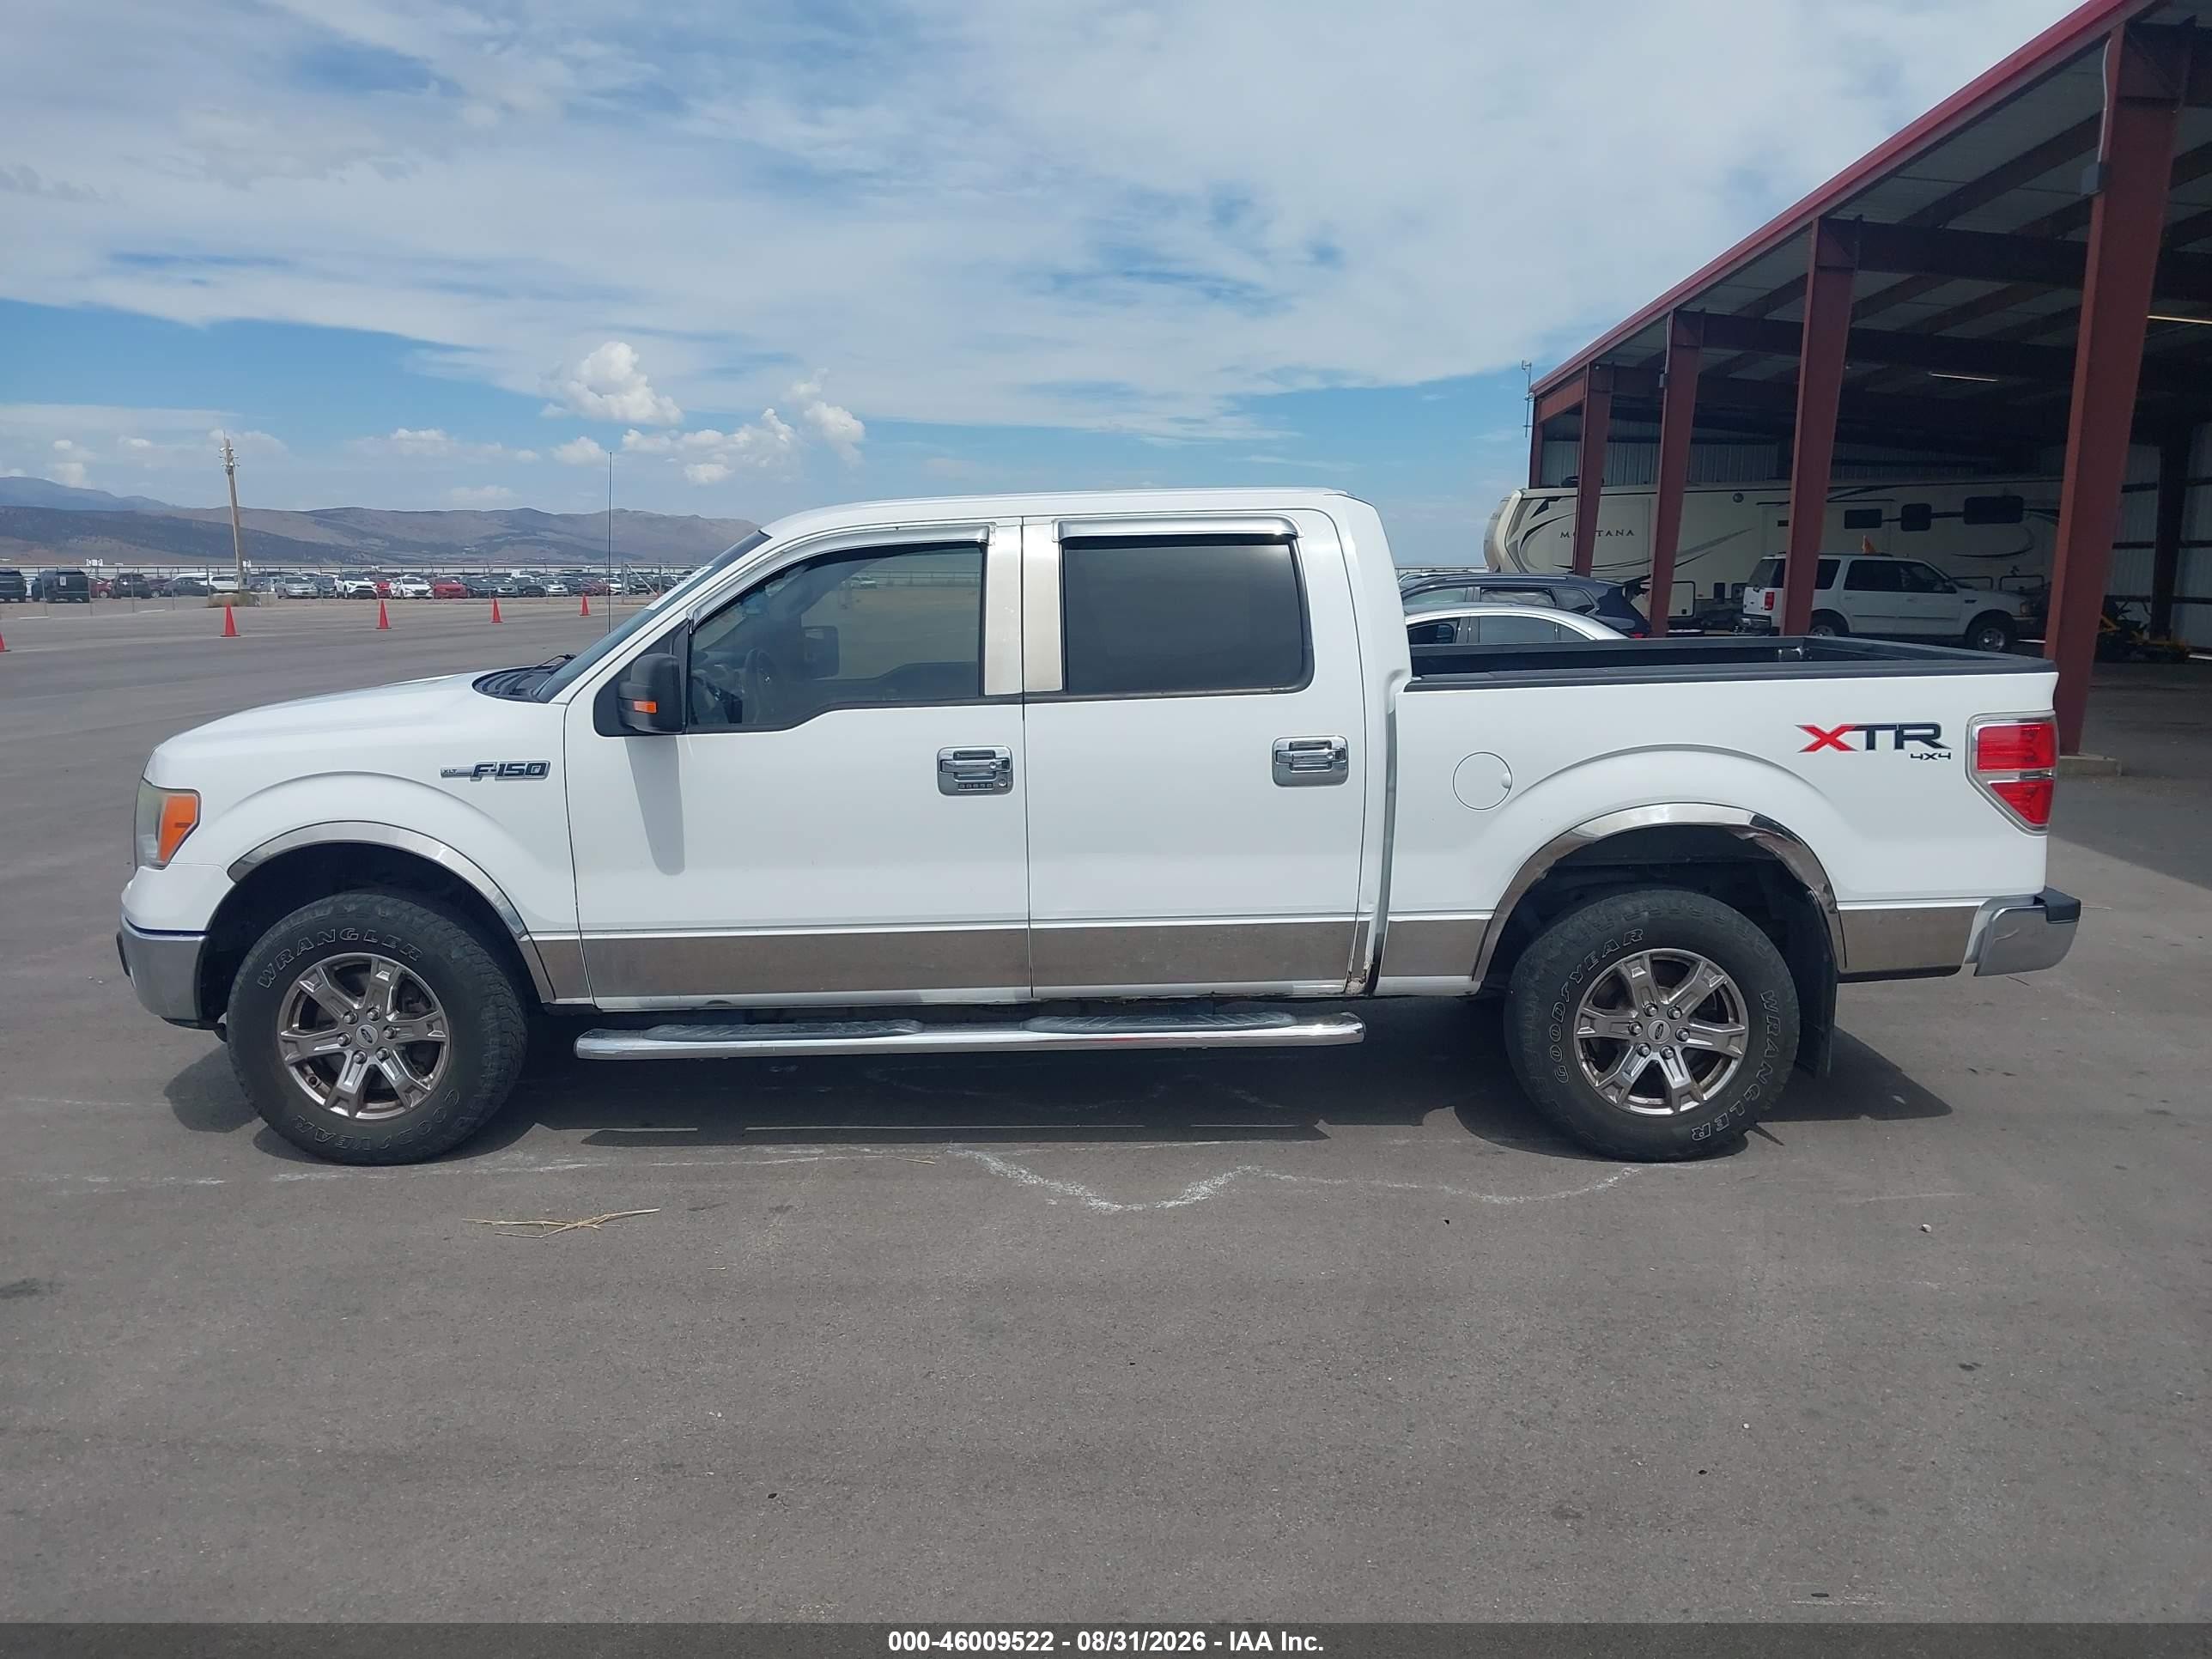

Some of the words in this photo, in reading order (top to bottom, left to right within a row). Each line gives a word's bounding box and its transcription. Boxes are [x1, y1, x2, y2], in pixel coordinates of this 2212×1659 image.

[1559, 528, 1635, 539] MTANA
[1795, 722, 1952, 753] XTR
[471, 761, 549, 779] F-150
[257, 927, 426, 988] WRANGLER
[1548, 928, 1644, 1084] GOODYEAR
[1691, 989, 1782, 1142] WRANGLER
